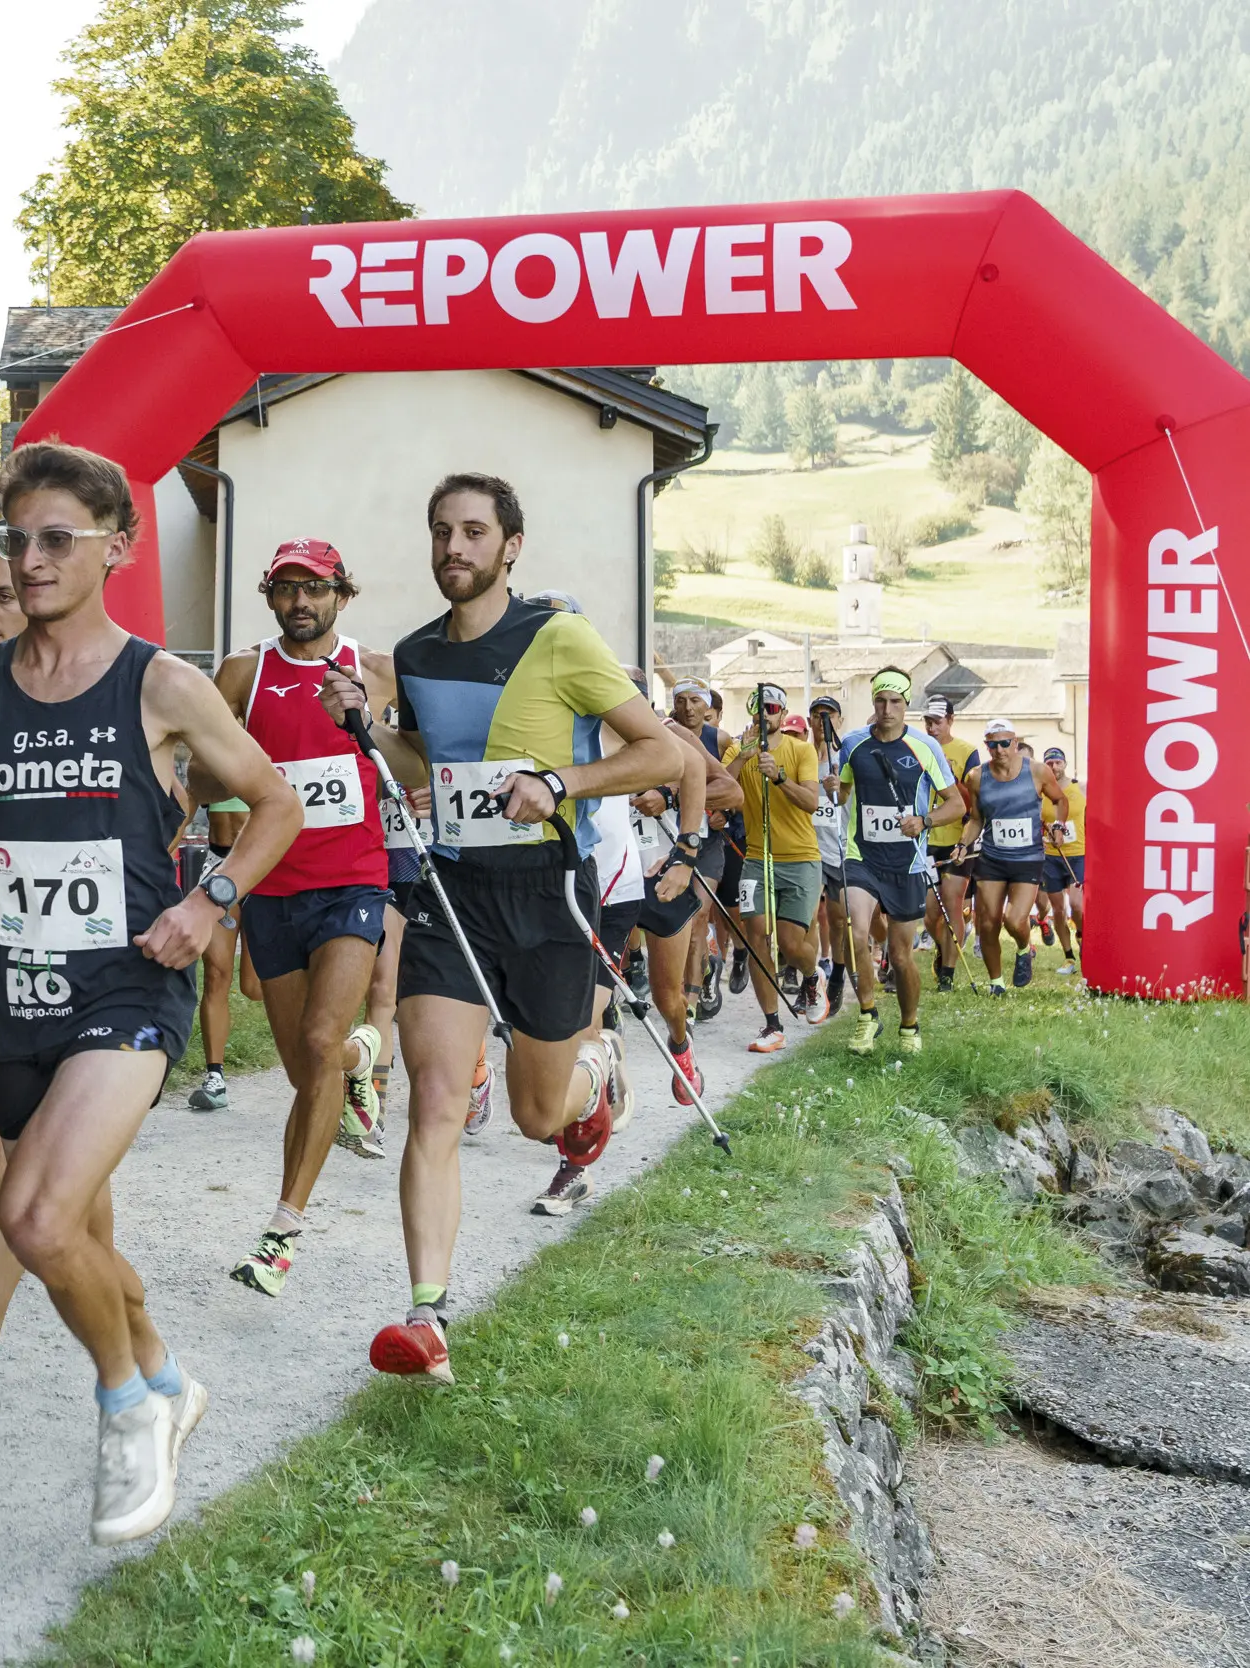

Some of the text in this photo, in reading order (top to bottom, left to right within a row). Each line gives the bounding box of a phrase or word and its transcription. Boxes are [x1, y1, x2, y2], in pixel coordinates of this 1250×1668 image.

[309, 221, 858, 328] REPOWER
[1143, 526, 1218, 931] REPOWER
[13, 729, 74, 753] g.s.a.
[291, 779, 346, 807] 29
[449, 789, 497, 819] 12
[385, 814, 421, 832] 13
[815, 806, 835, 817] 59
[1000, 828, 1025, 838] 101
[8, 877, 99, 916] 170
[740, 890, 747, 901] 3
[9, 1005, 73, 1020] livigno.com
